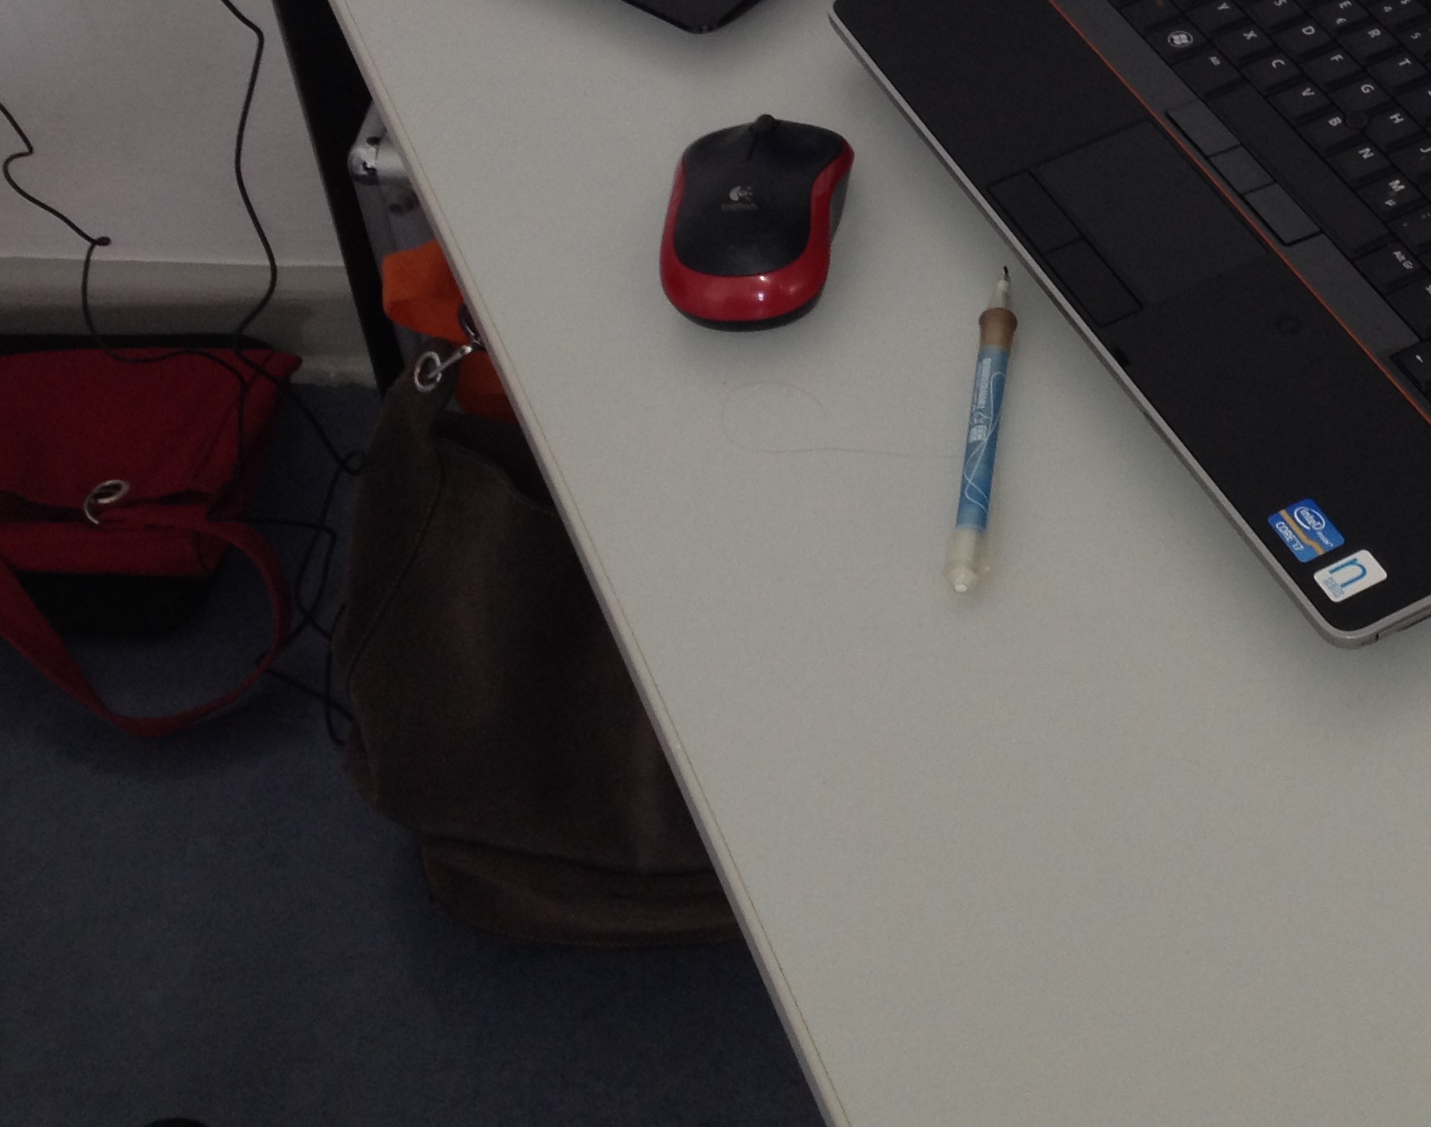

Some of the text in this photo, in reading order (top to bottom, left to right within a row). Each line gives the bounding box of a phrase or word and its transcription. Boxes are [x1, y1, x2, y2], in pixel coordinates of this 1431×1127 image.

[1217, 2, 1230, 11] Y
[1339, 0, 1352, 9] E
[1243, 30, 1258, 40] X
[1302, 25, 1316, 35] D
[1368, 28, 1381, 38] R
[1330, 54, 1344, 62] F
[1398, 58, 1412, 67] T
[1271, 59, 1285, 68] C
[1302, 87, 1315, 97] V
[1361, 84, 1374, 94] G
[1328, 117, 1342, 126] B
[1389, 113, 1404, 124] H
[1358, 147, 1374, 159] N
[1388, 179, 1405, 192] M
[1275, 521, 1294, 543] CORE
